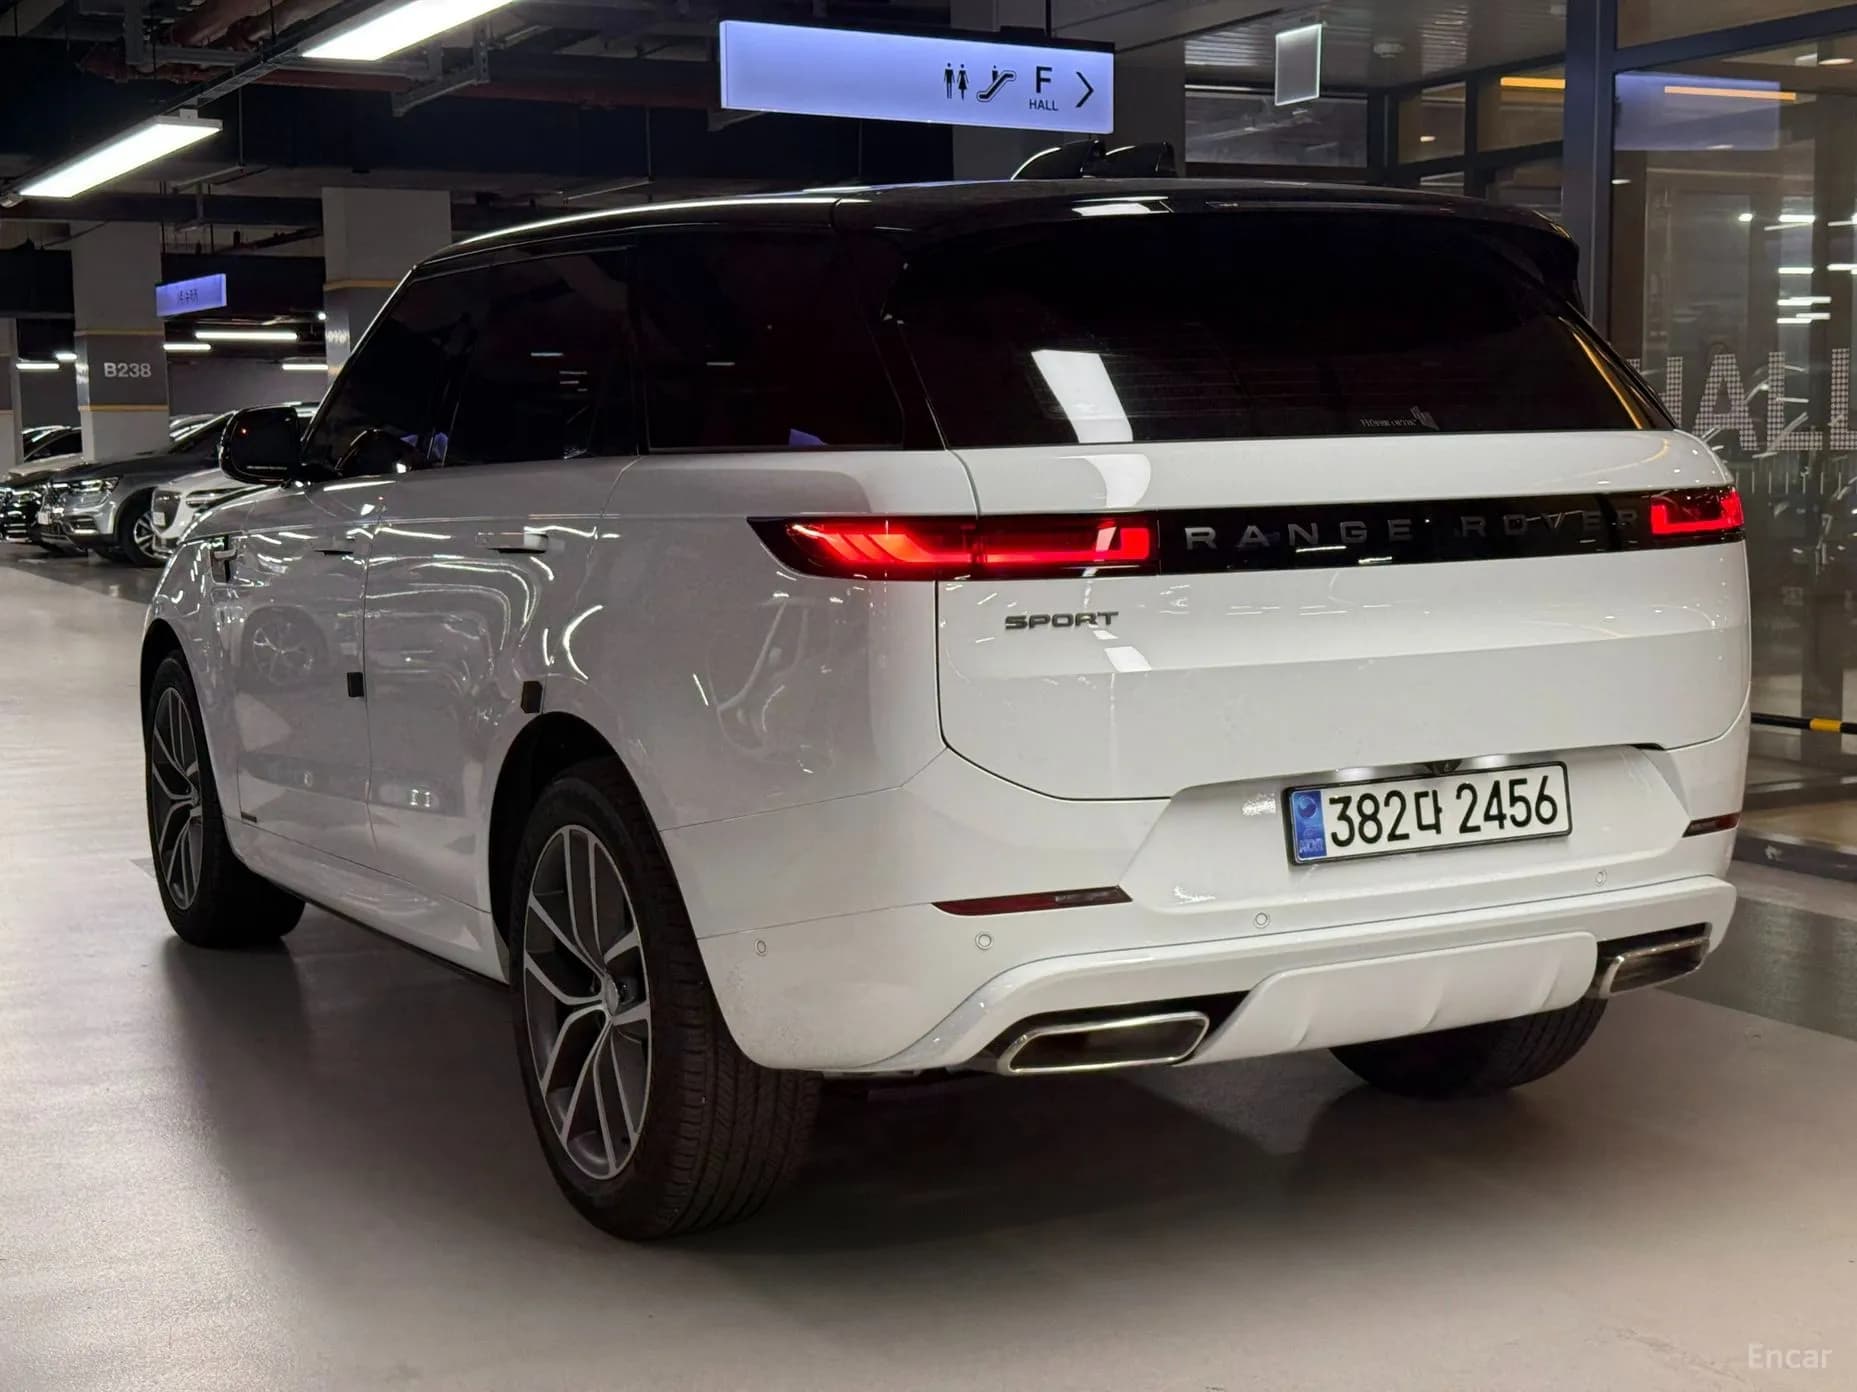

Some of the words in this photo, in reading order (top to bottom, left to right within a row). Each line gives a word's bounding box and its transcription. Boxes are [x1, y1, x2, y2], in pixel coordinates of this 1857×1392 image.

[1035, 65, 1053, 94] F
[1029, 98, 1059, 111] HALL
[104, 362, 151, 378] B238
[1184, 519, 1413, 550] RANGE
[1460, 508, 1639, 539] ROVER
[1005, 611, 1119, 630] SPORT
[1329, 789, 1442, 847] 382다
[1456, 775, 1558, 834] 2456
